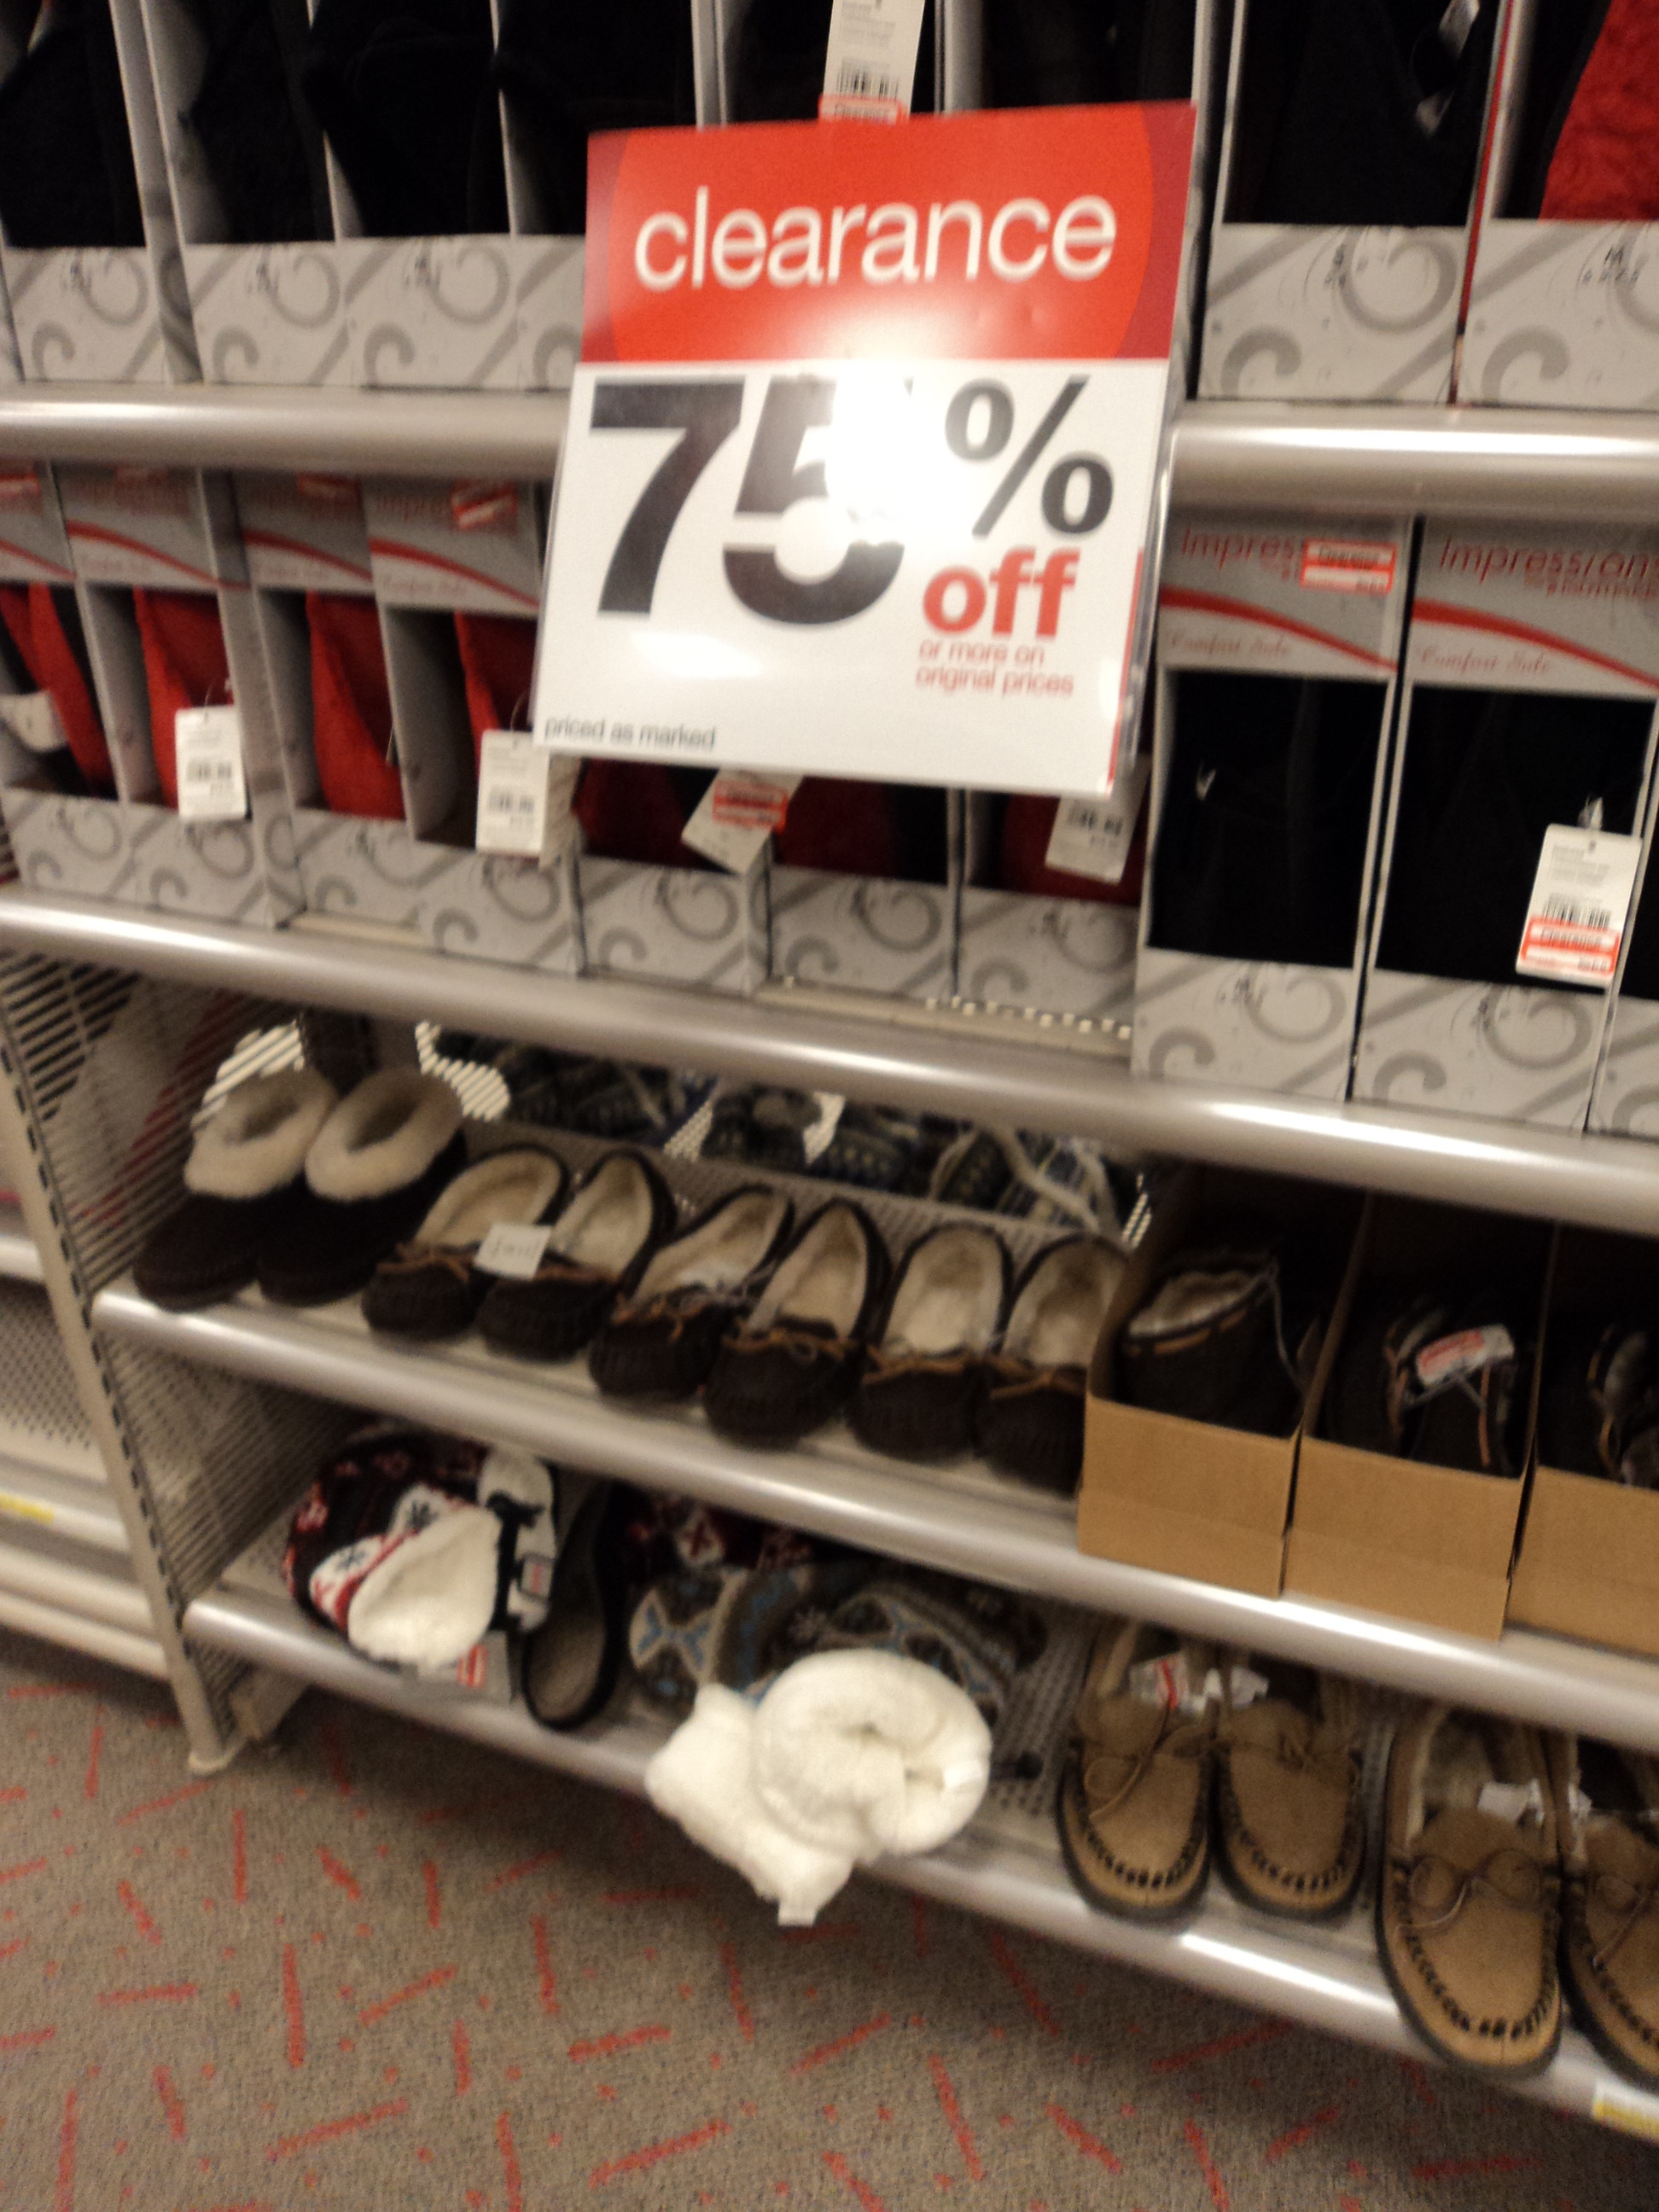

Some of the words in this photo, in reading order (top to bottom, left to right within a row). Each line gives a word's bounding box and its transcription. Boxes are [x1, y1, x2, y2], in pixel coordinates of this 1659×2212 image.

[634, 186, 1117, 292] clearance
[922, 544, 1081, 643] off
[918, 639, 942, 661] or
[948, 641, 1009, 667] more
[1014, 644, 1045, 667] on
[915, 665, 997, 696] original
[1001, 669, 1074, 698] prices
[544, 715, 606, 743] priced
[610, 721, 634, 745] as
[638, 723, 717, 751] marked
